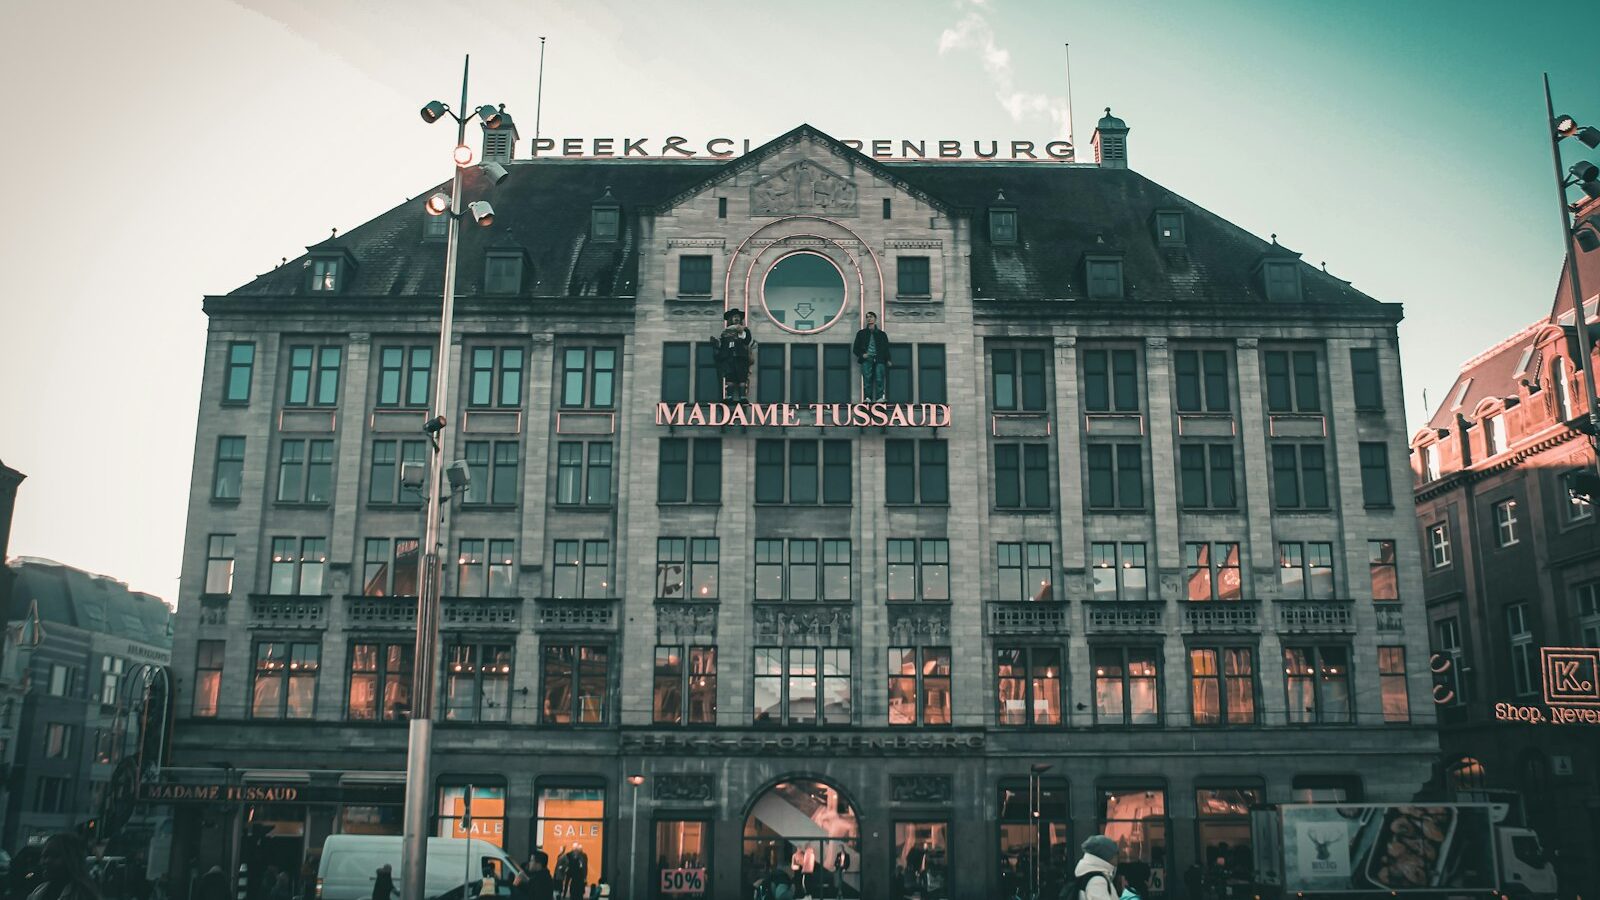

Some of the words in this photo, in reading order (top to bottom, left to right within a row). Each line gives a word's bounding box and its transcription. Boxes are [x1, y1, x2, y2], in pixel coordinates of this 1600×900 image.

[531, 138, 649, 156] PEEK
[662, 136, 697, 156] &
[656, 402, 800, 427] MADAME
[810, 402, 951, 427] TUSSAUD
[1495, 702, 1546, 724] Shop.
[150, 785, 219, 799] MADAME
[458, 822, 503, 835] SALE
[553, 824, 599, 837] SALE
[663, 871, 702, 890] 50%
